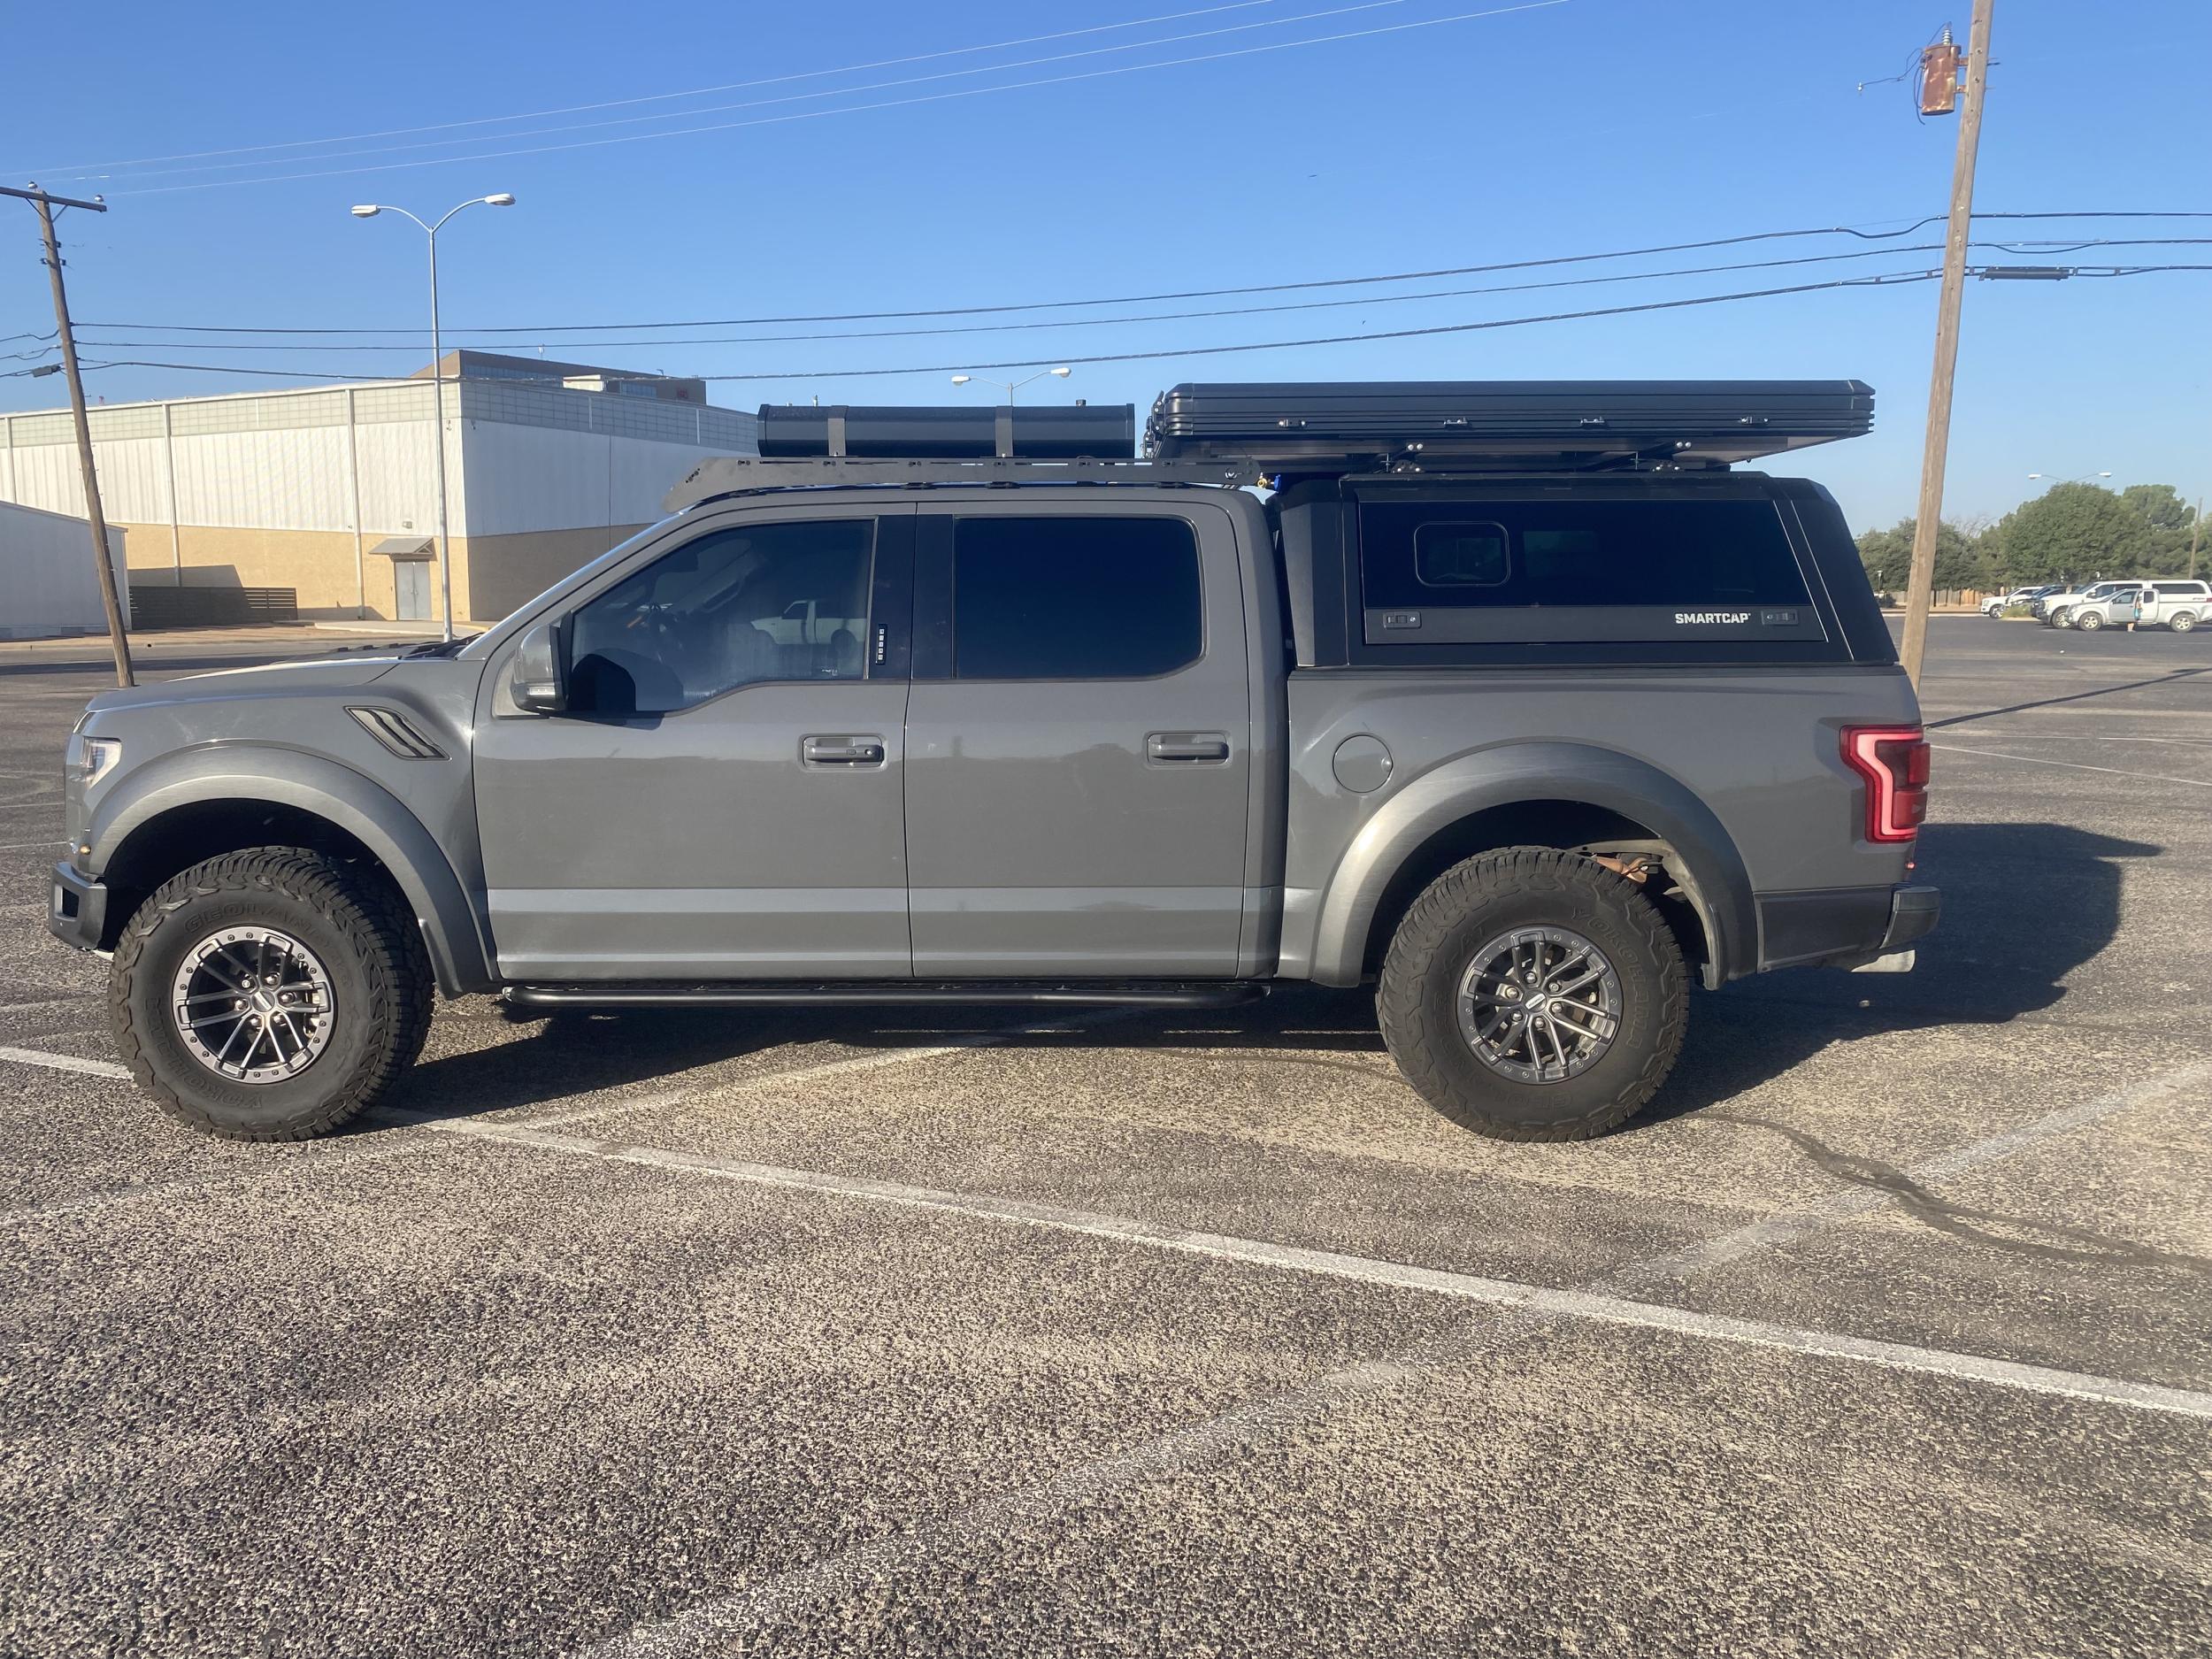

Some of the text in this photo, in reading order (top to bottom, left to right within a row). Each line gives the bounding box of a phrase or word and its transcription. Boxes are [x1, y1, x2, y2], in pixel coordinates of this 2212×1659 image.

[1675, 612, 1749, 624] SMARTCAP
[1571, 905, 1650, 1049] YOKOHAMA
[144, 996, 264, 1110] YOKOHAMA
